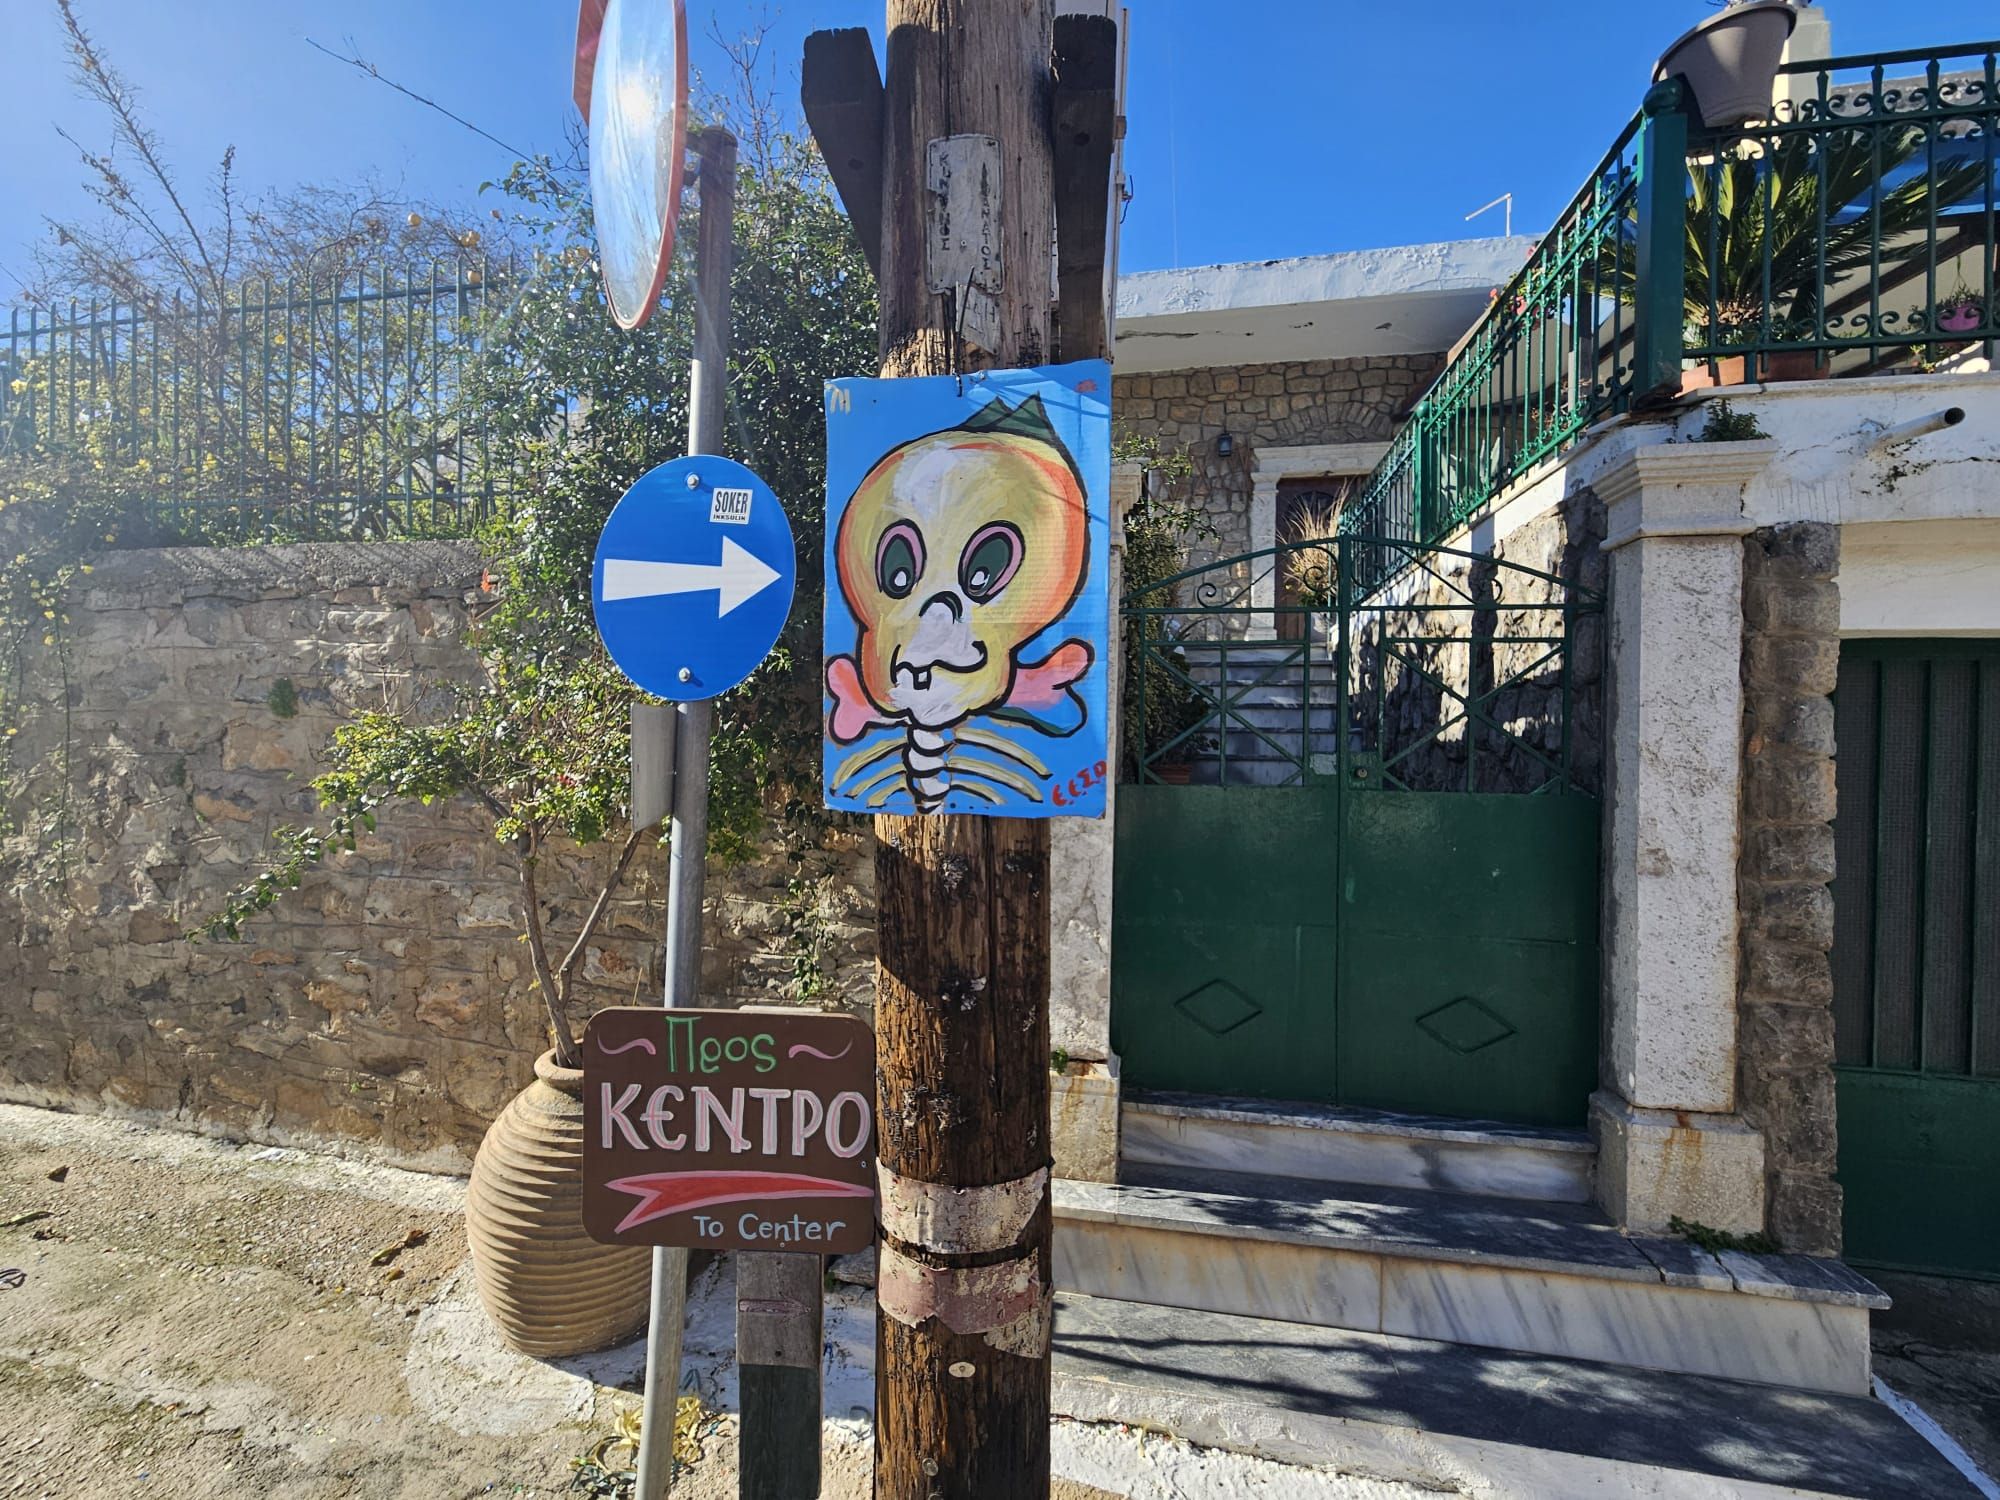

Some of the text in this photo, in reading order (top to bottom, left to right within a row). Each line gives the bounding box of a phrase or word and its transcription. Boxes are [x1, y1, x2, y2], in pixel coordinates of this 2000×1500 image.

[714, 490, 749, 513] SOKER
[601, 1082, 871, 1158] ΚΕΝΤΡΟ
[692, 1213, 846, 1242] To Center
